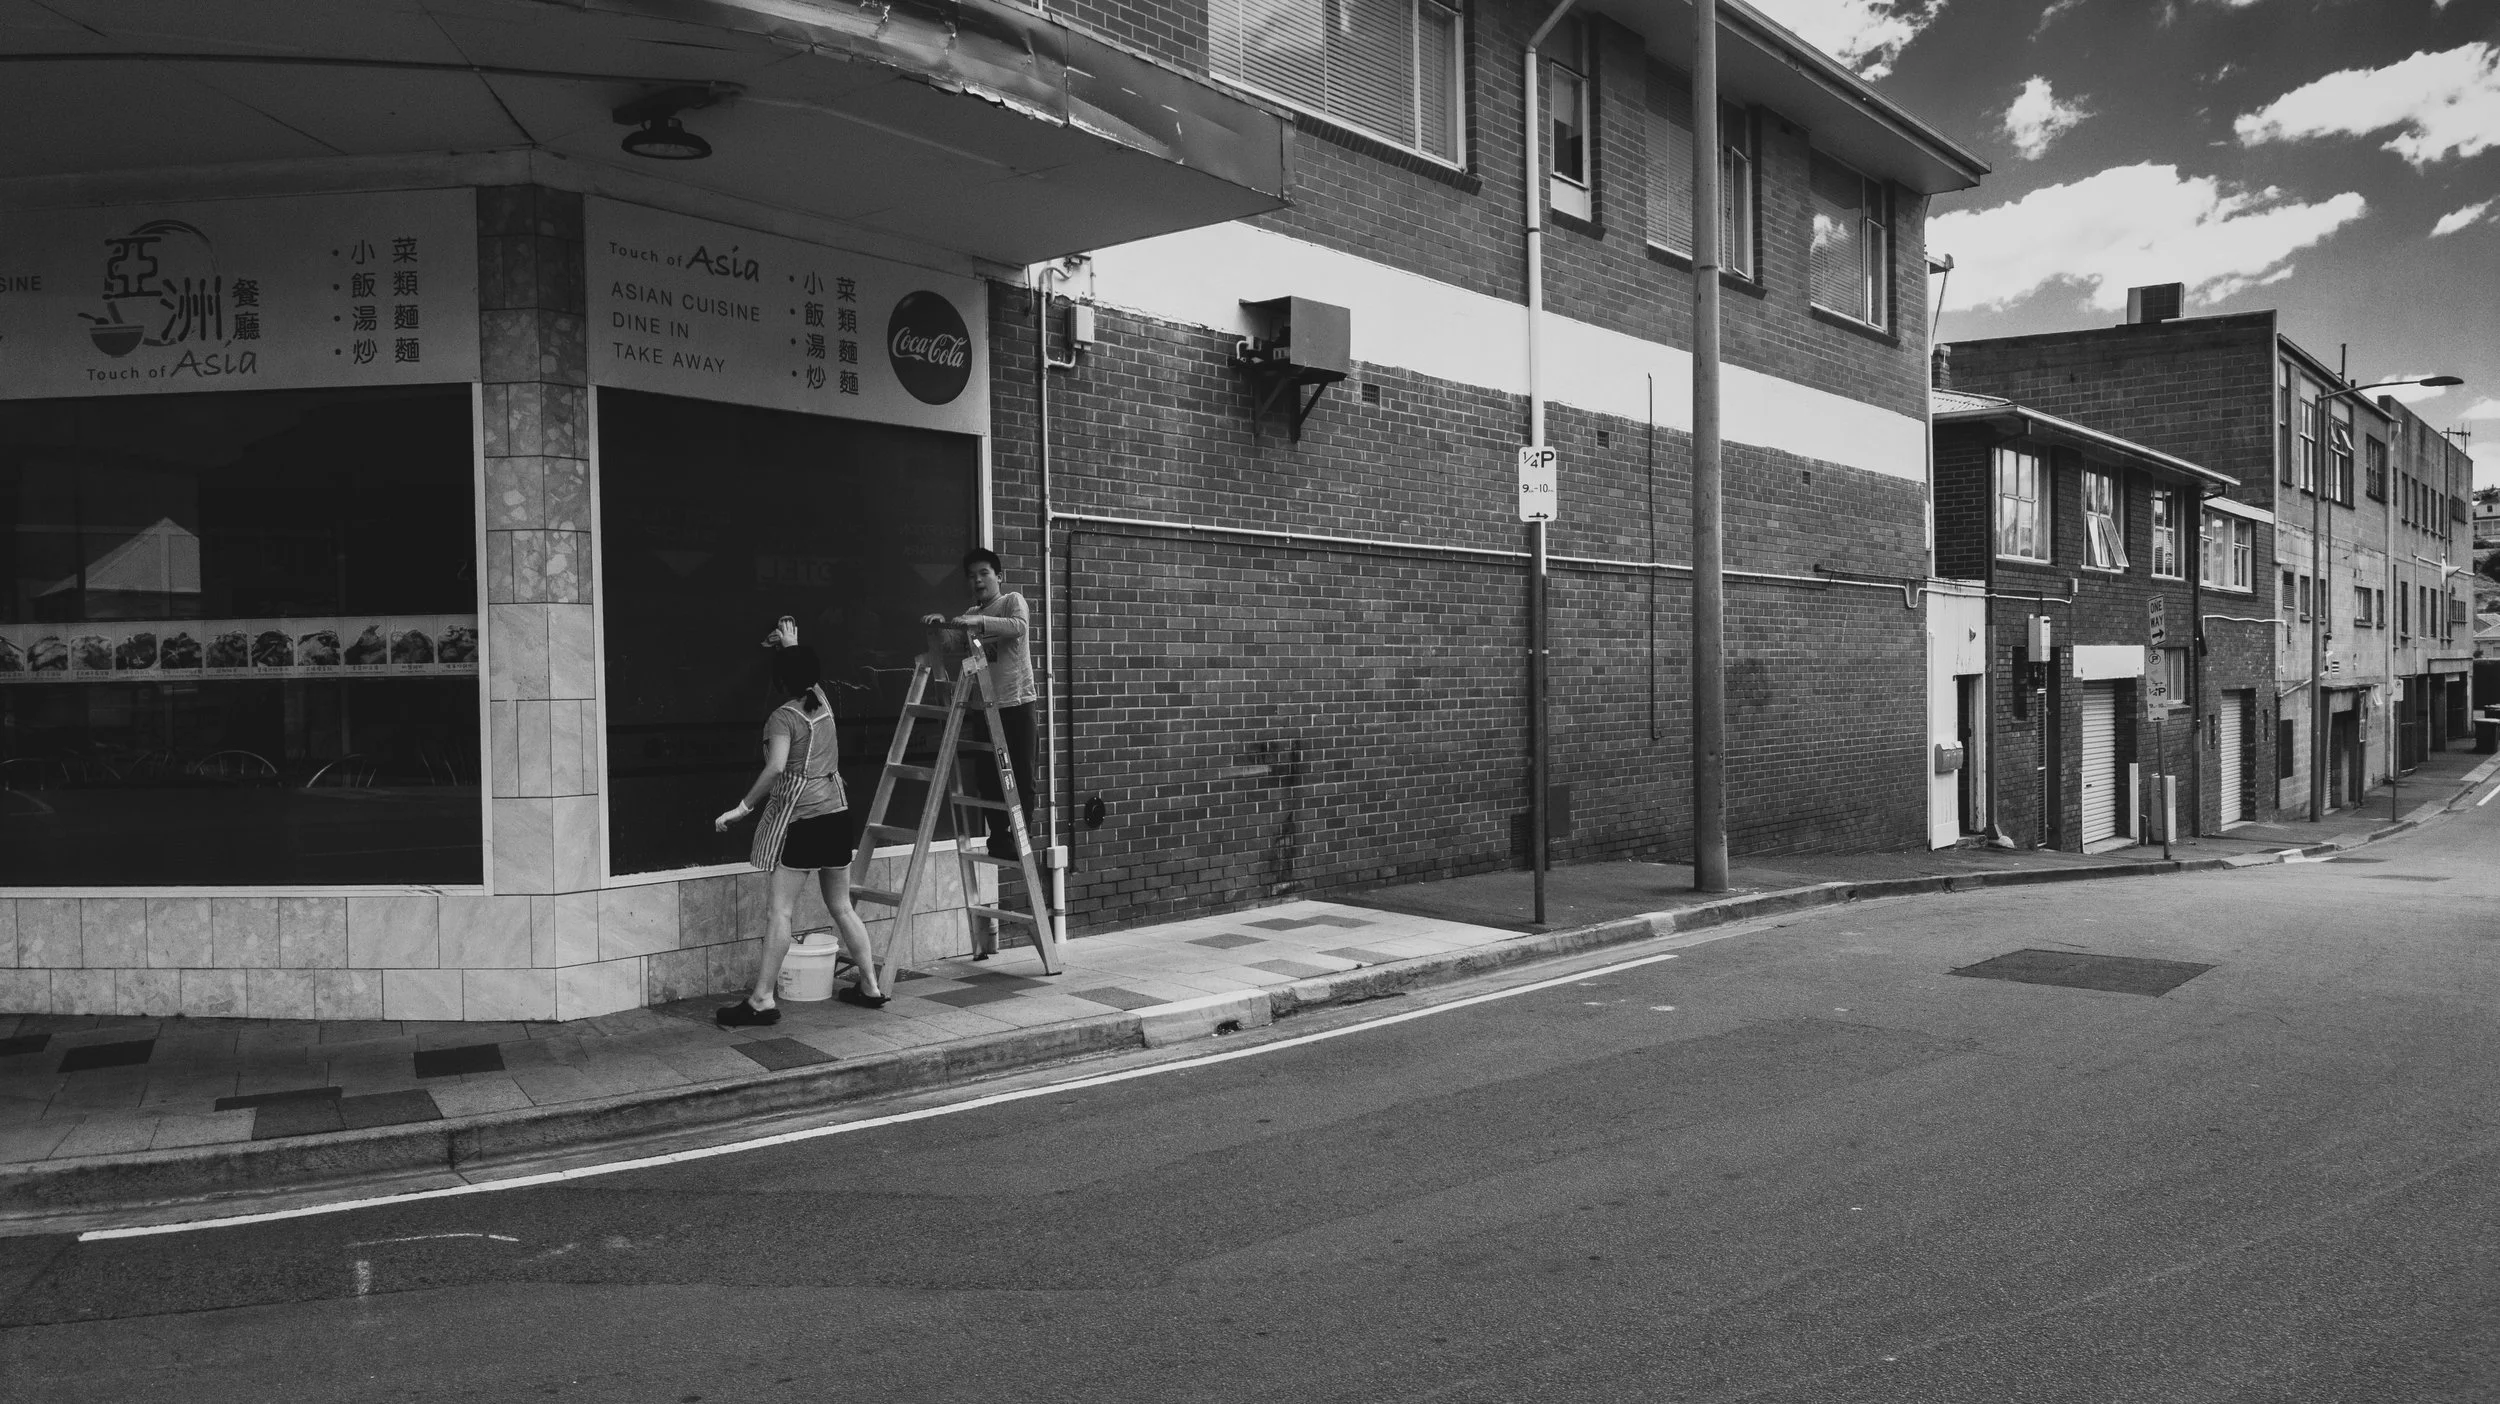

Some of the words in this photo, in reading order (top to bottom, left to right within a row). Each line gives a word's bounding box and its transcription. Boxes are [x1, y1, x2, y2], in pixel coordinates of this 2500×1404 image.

[609, 241, 659, 263] Touch
[667, 255, 683, 267] of
[686, 245, 760, 282] Asia
[232, 278, 261, 341] 餐廳
[611, 281, 672, 307] ASIAN
[682, 294, 760, 322] CUISINE
[613, 312, 661, 334] DINE
[670, 321, 689, 339] IN
[87, 367, 140, 381] Touch
[149, 366, 167, 378] of
[170, 340, 257, 377] Asia
[613, 342, 663, 364] TAKE
[673, 352, 725, 373] AWAY
[892, 326, 967, 367] Coca-Cola
[2150, 600, 2162, 614] ONE
[2151, 614, 2163, 628] WAY
